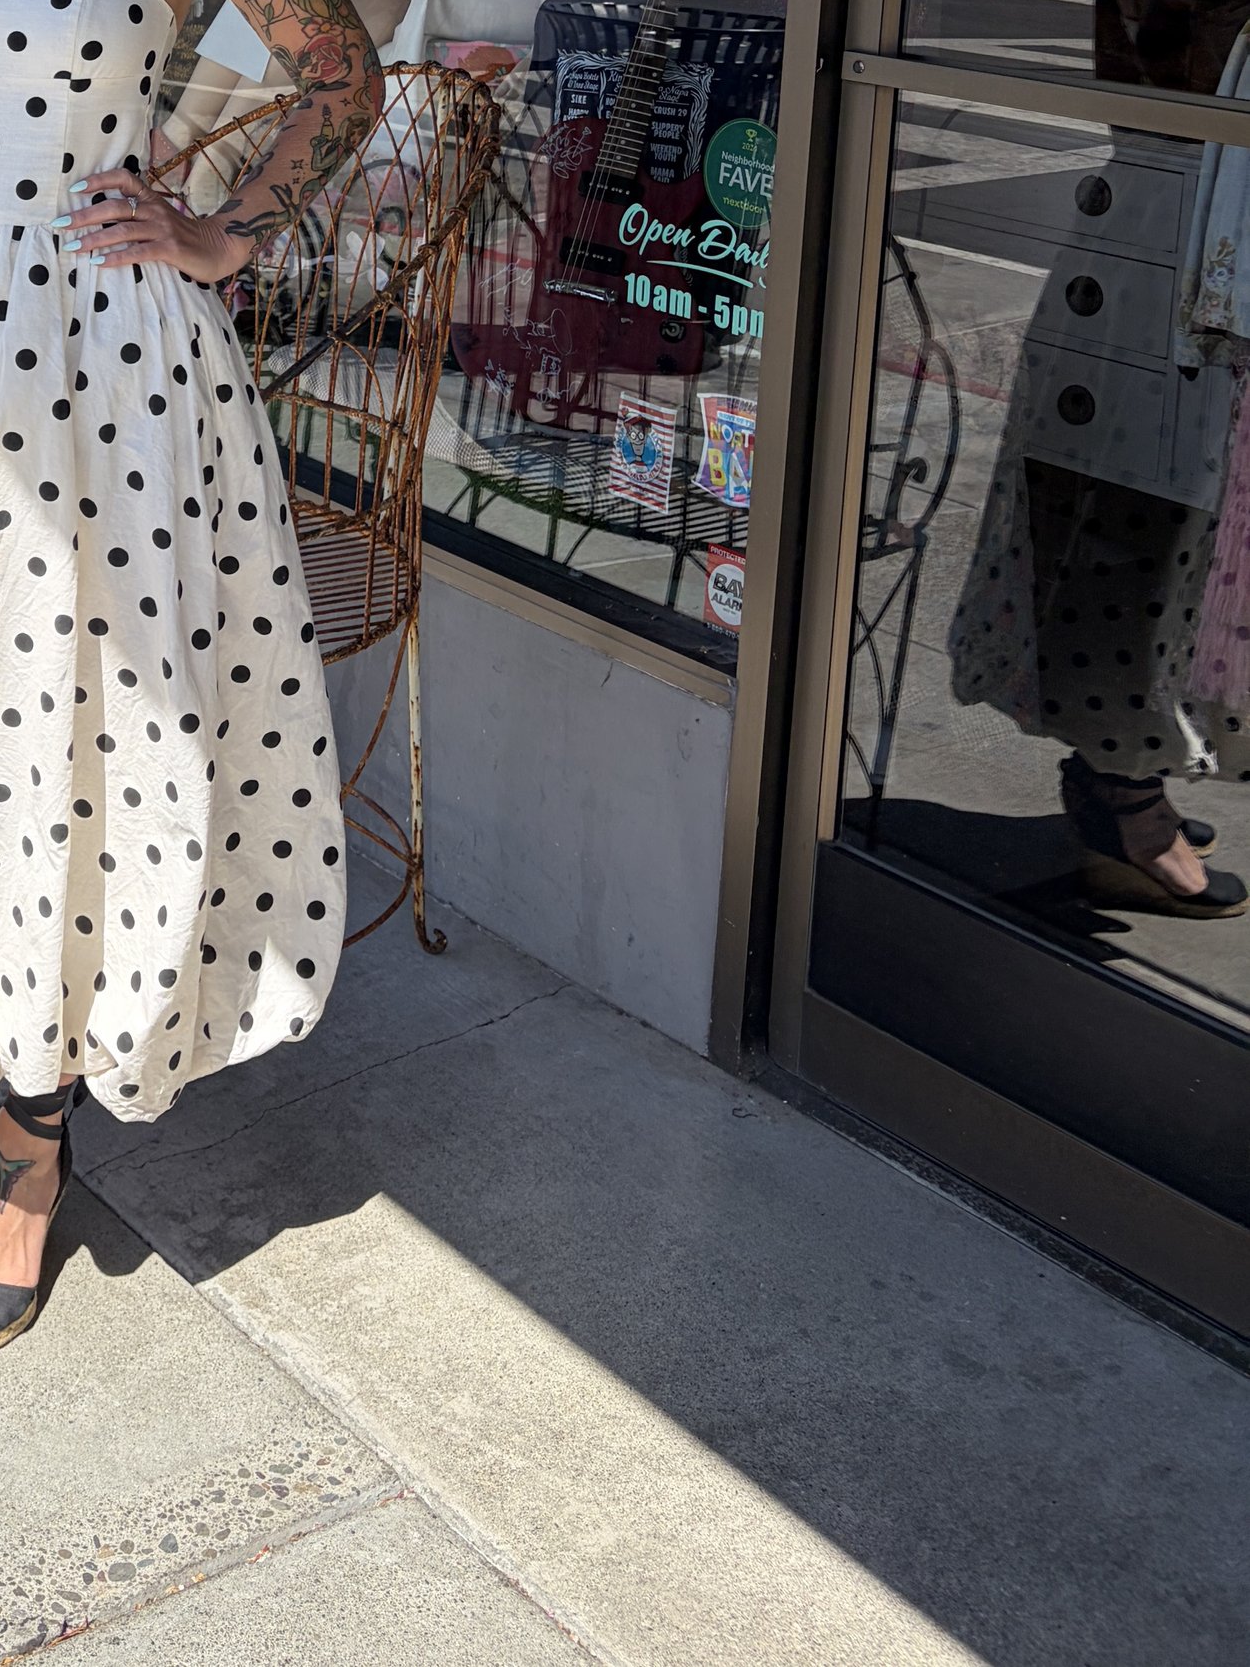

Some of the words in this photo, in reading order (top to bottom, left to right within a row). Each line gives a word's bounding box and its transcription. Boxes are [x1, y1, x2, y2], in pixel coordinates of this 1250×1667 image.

[653, 106, 675, 117] CRUSH
[677, 108, 688, 117] 29
[651, 121, 685, 134] SLIPPERY
[653, 130, 680, 140] PEOPLE
[650, 143, 682, 155] WEEKEND
[654, 152, 677, 162] YOUTH
[721, 150, 775, 173] Neighborhood
[650, 167, 674, 177] MAMA
[722, 196, 767, 215] nextdoor
[619, 202, 696, 256] Open
[697, 219, 770, 289] Dail
[624, 272, 692, 320] 10am
[709, 421, 754, 450] NORT
[707, 447, 753, 499] BA
[711, 592, 742, 612] ALAR
